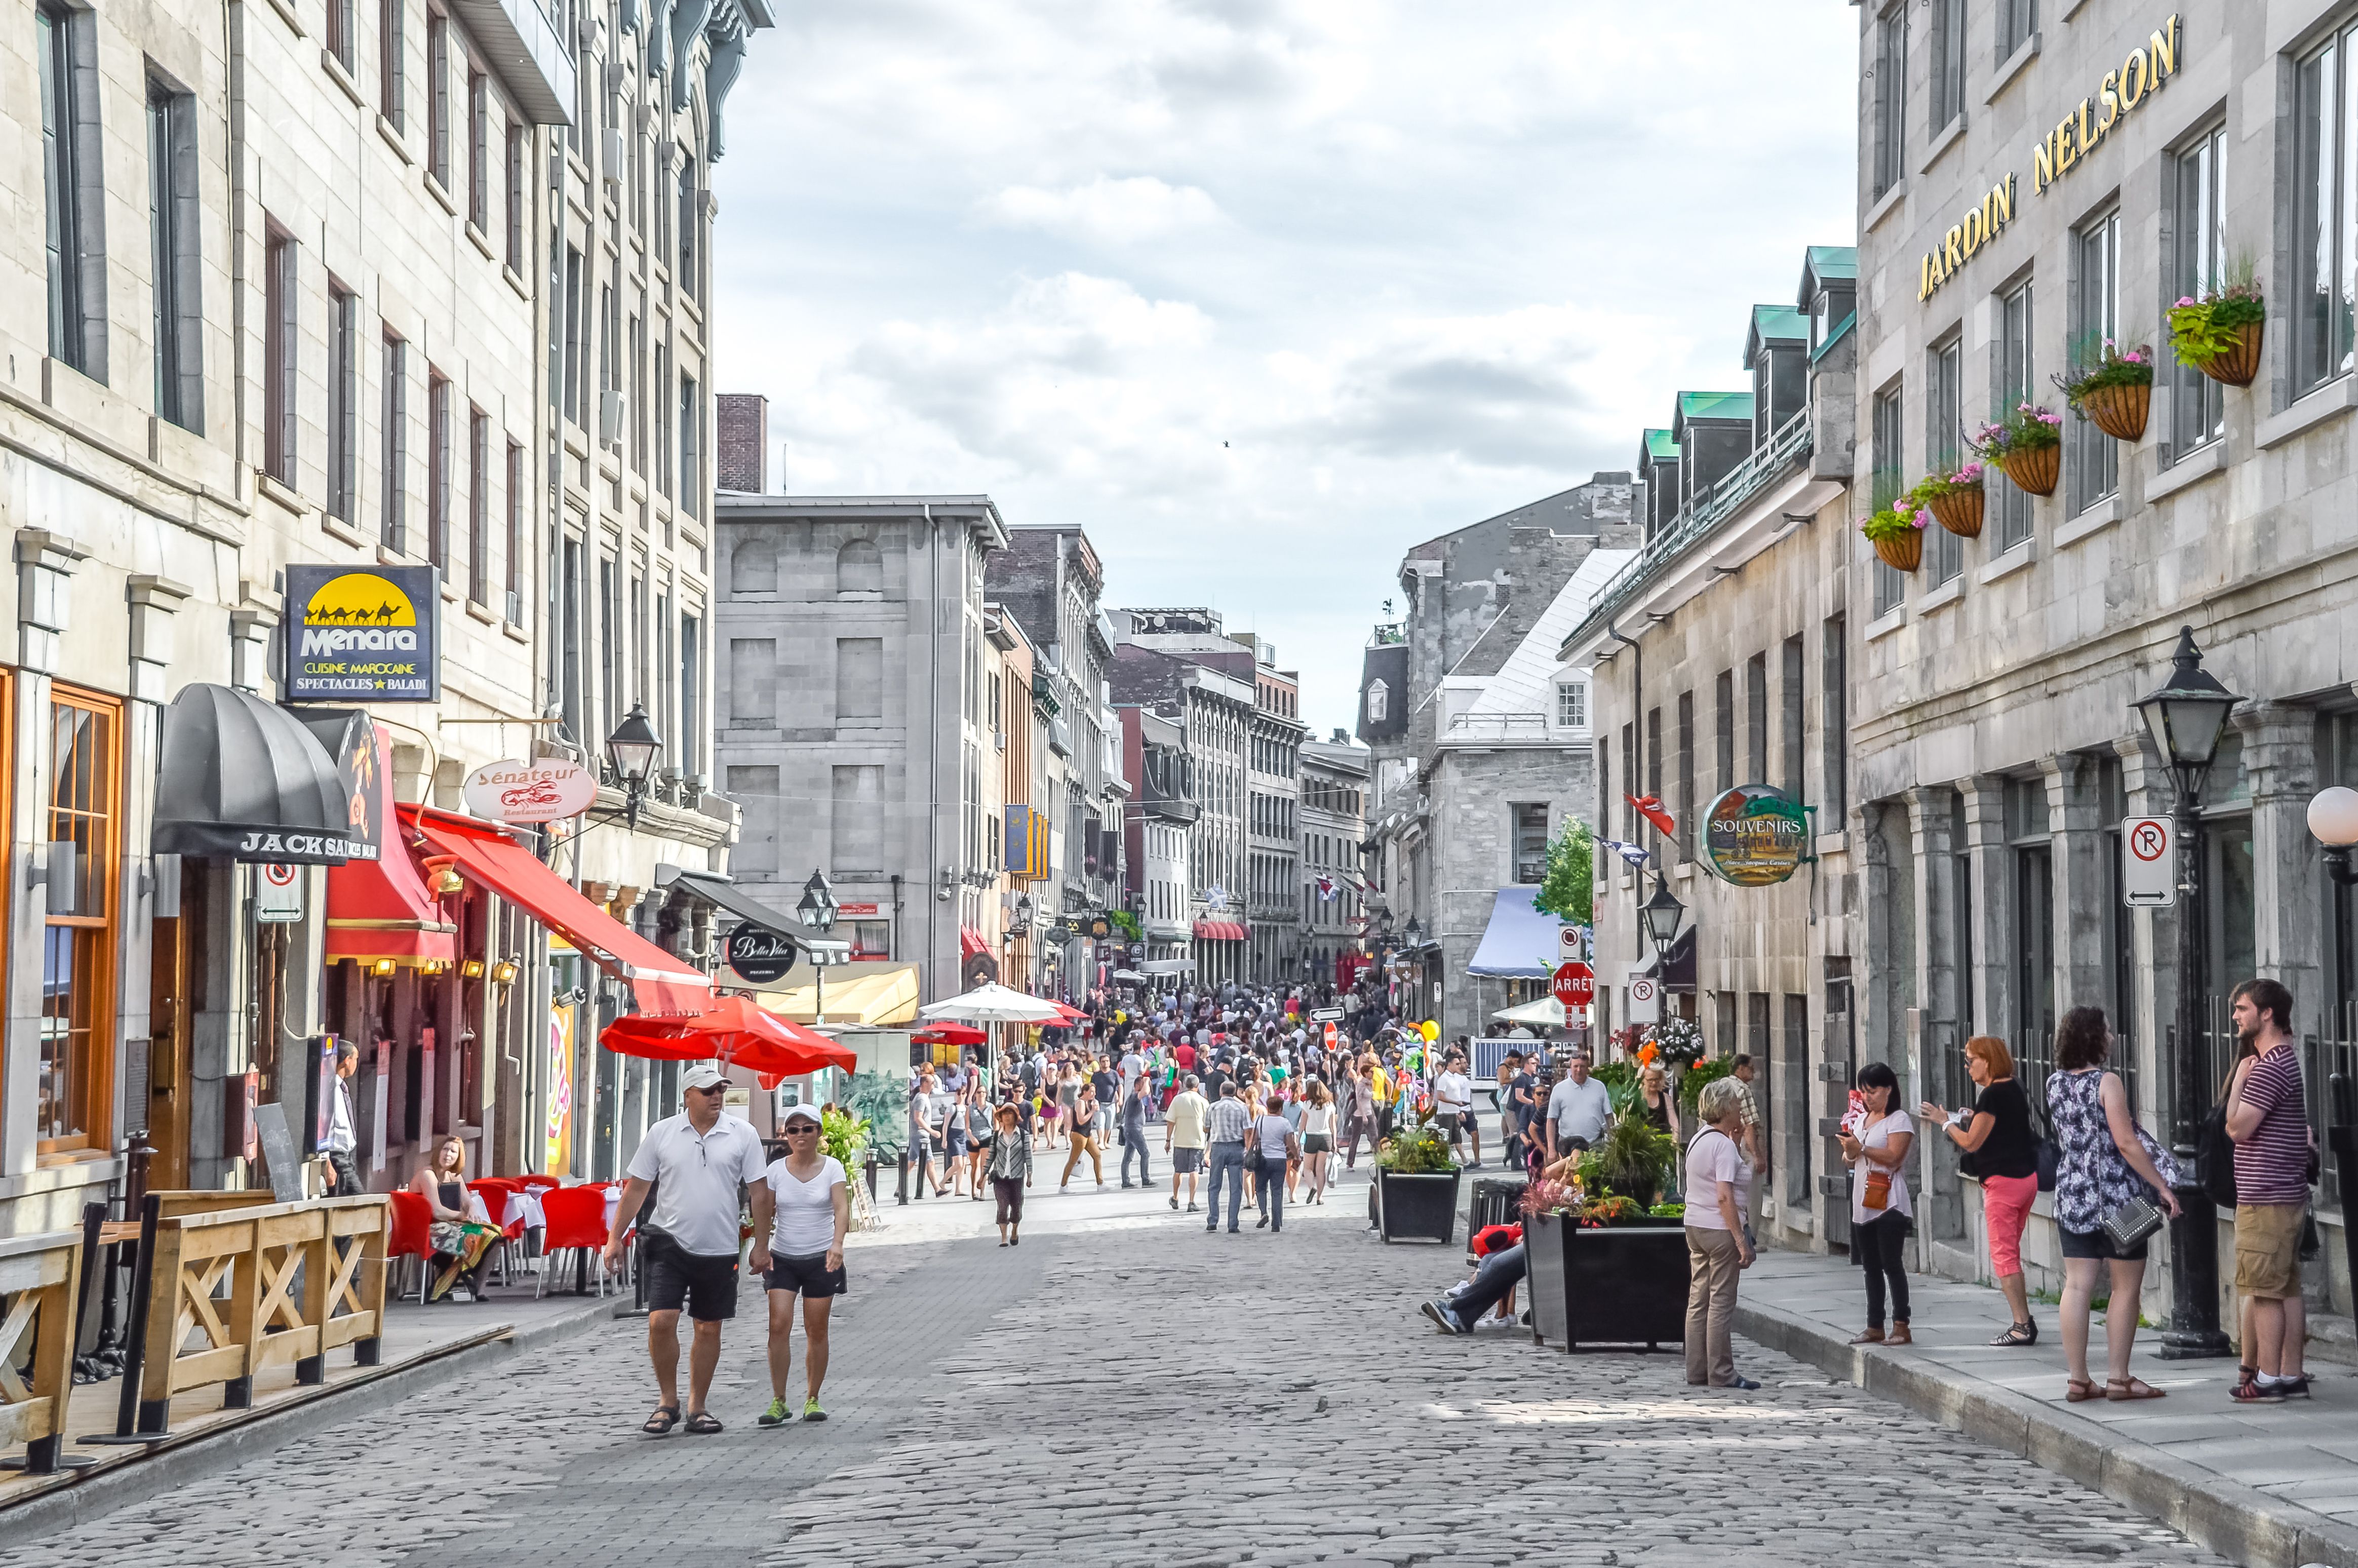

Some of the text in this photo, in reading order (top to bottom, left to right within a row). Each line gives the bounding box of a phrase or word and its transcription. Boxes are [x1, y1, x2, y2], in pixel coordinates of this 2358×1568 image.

[1917, 13, 2179, 303] JARDIN NELSON
[300, 629, 417, 657] Menara
[304, 662, 416, 675] CUISINE MAROCAINE
[296, 678, 426, 690] SPECTACLES BALADI
[503, 808, 557, 816] Restaurant
[1714, 820, 1801, 833] SOUVENIRS
[732, 936, 769, 958] Bella
[1555, 975, 1594, 991] ARRÊT
